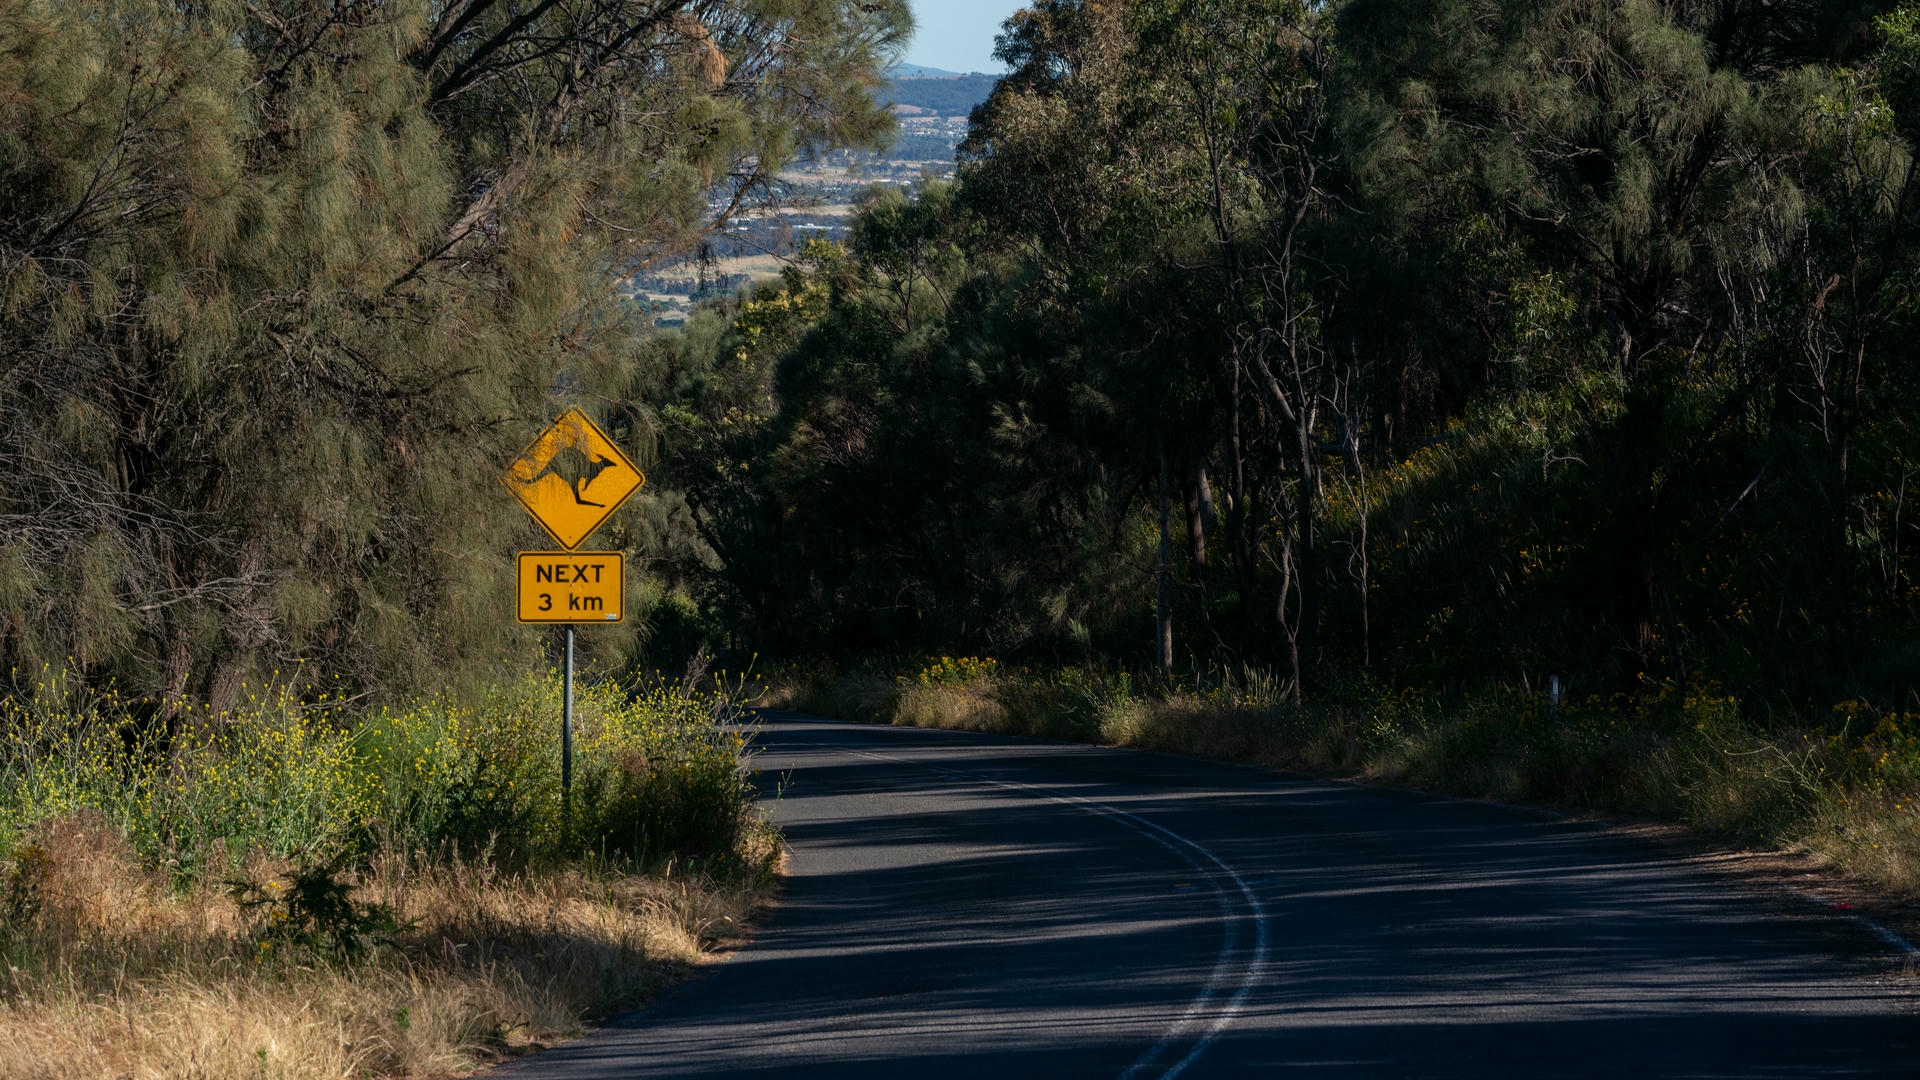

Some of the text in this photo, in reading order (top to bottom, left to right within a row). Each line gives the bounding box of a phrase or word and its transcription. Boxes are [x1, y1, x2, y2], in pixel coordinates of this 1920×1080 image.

[537, 565, 605, 582] NEXT
[538, 593, 603, 611] 3 km
